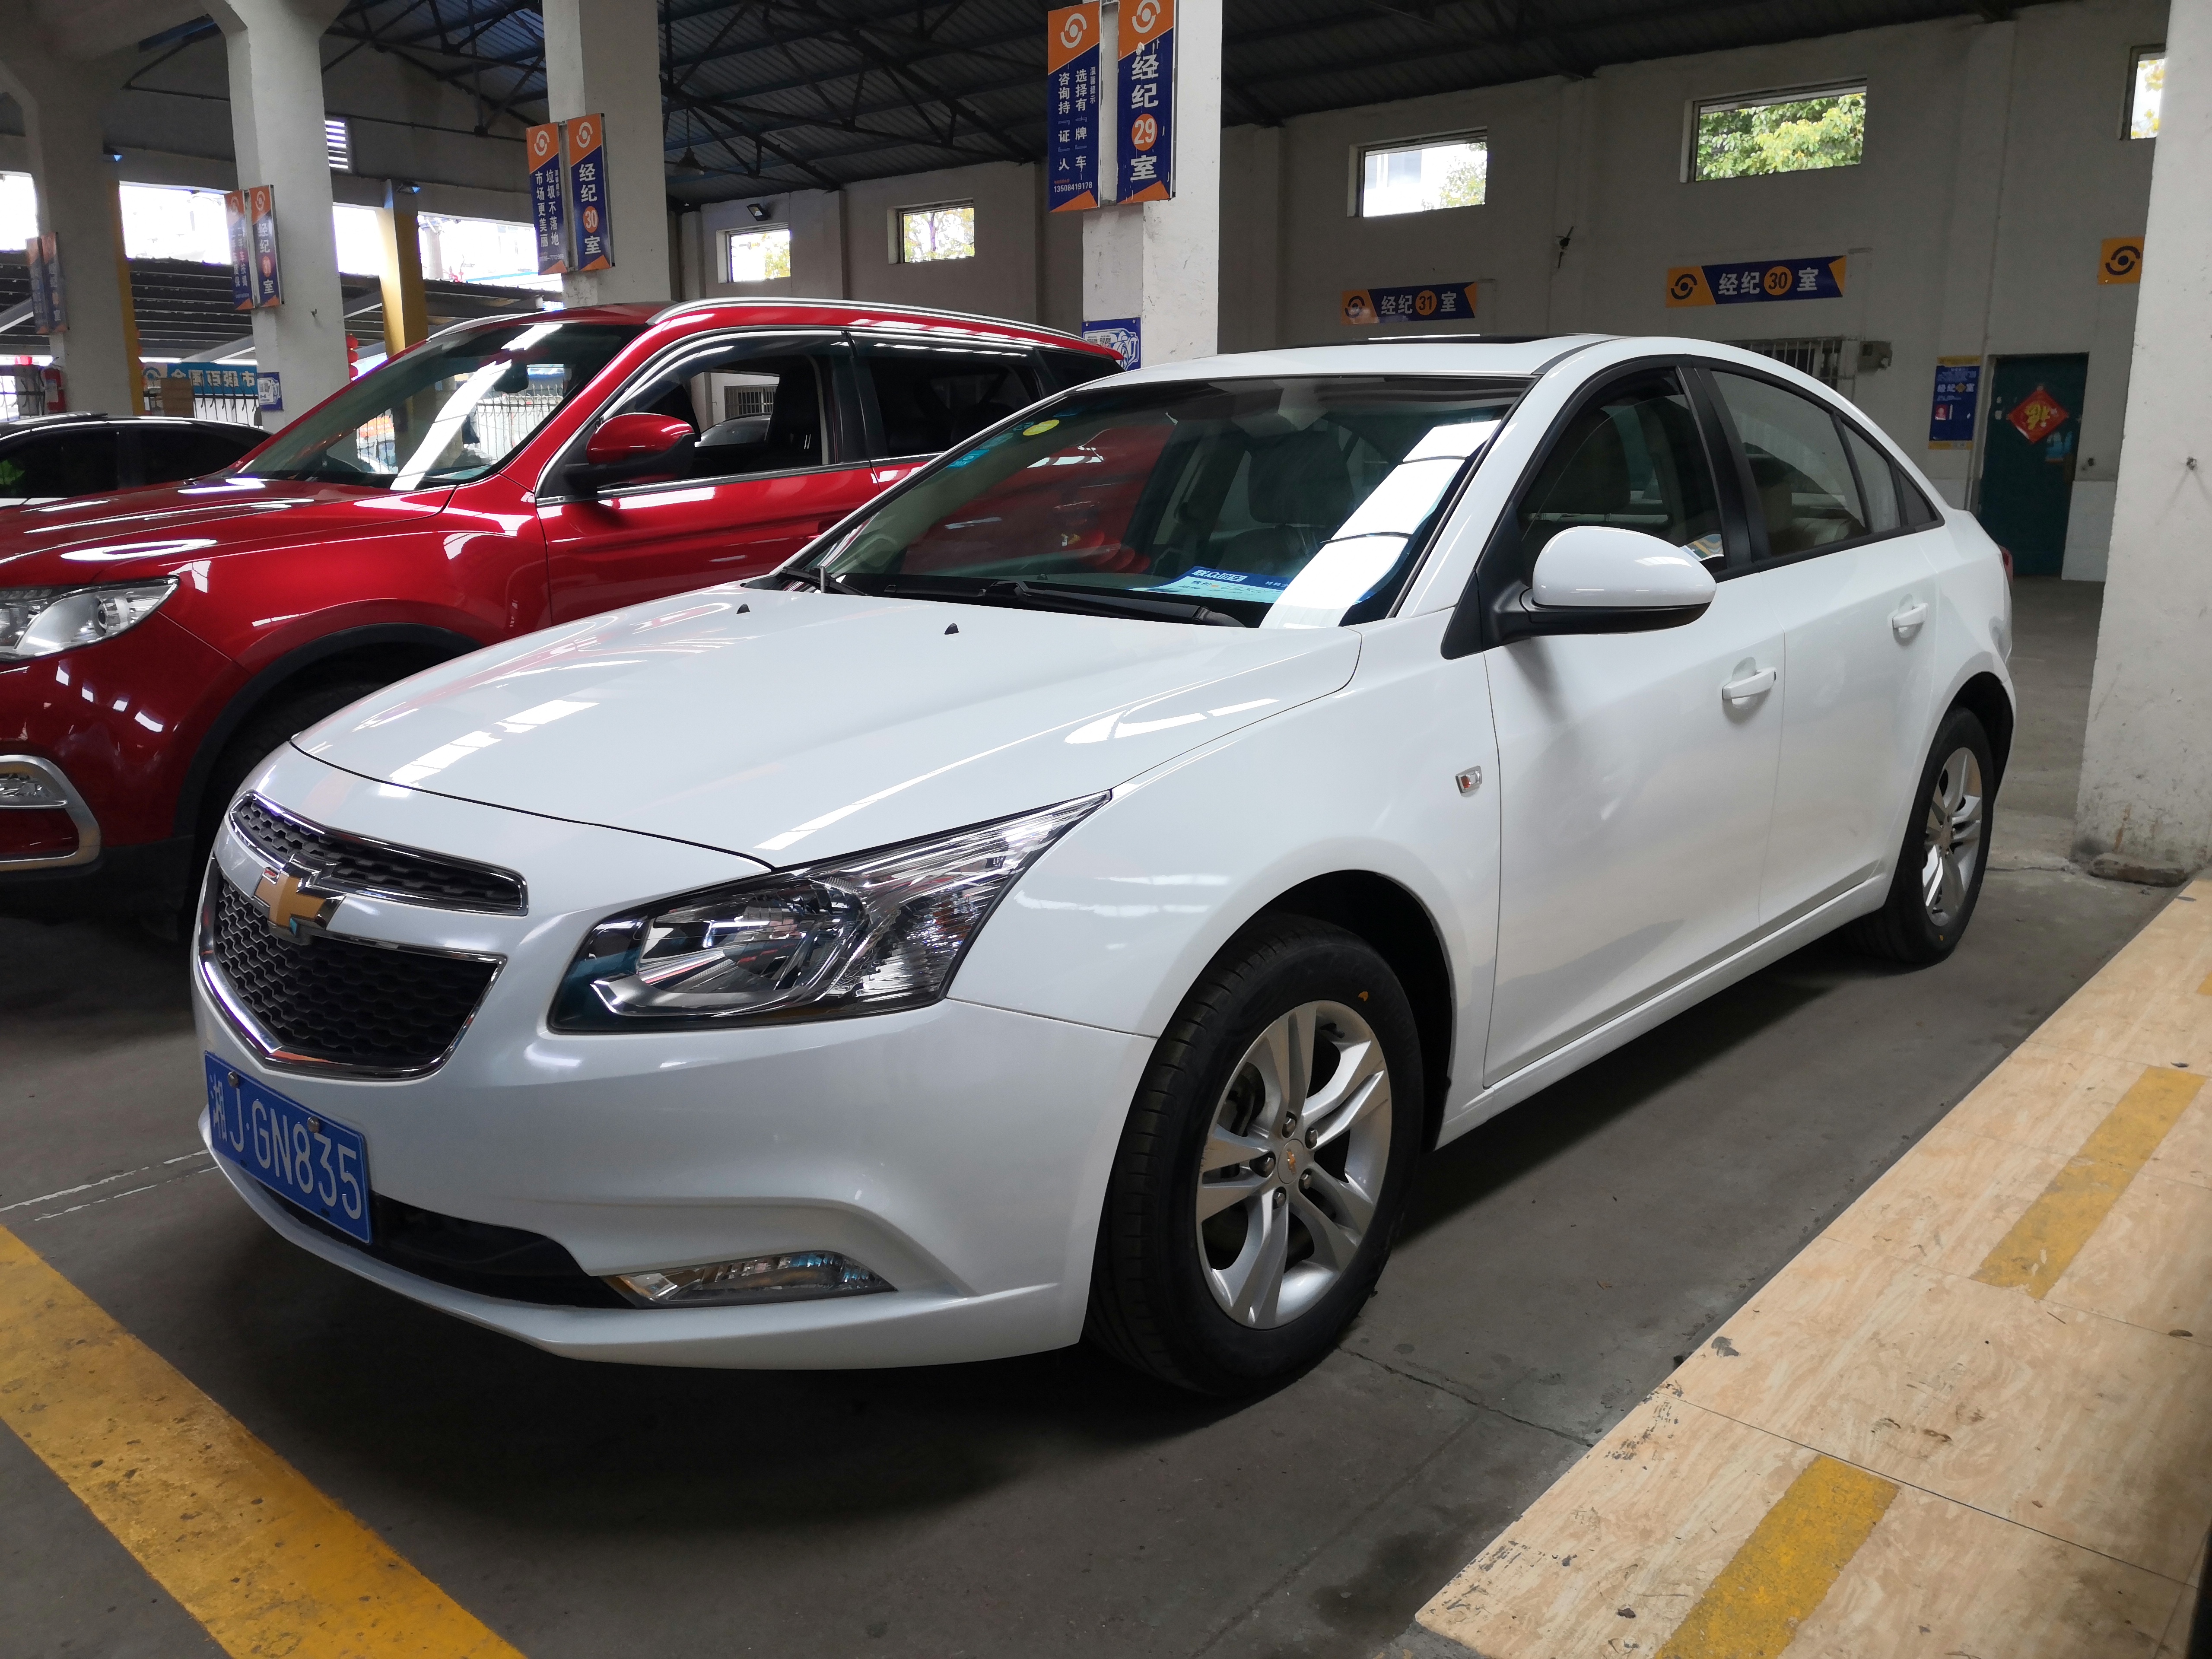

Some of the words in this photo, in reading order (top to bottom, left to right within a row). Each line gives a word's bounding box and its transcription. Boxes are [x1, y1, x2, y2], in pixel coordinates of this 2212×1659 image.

[1130, 54, 1159, 181] 经纪29室
[535, 171, 548, 248] 市场更美丽
[546, 169, 559, 246] 垃圾不落地
[579, 162, 601, 255] 经纪30室
[1053, 181, 1093, 193] 13508419178
[1381, 291, 1457, 315] 经纪31室
[1718, 267, 1820, 296] 经纪30室
